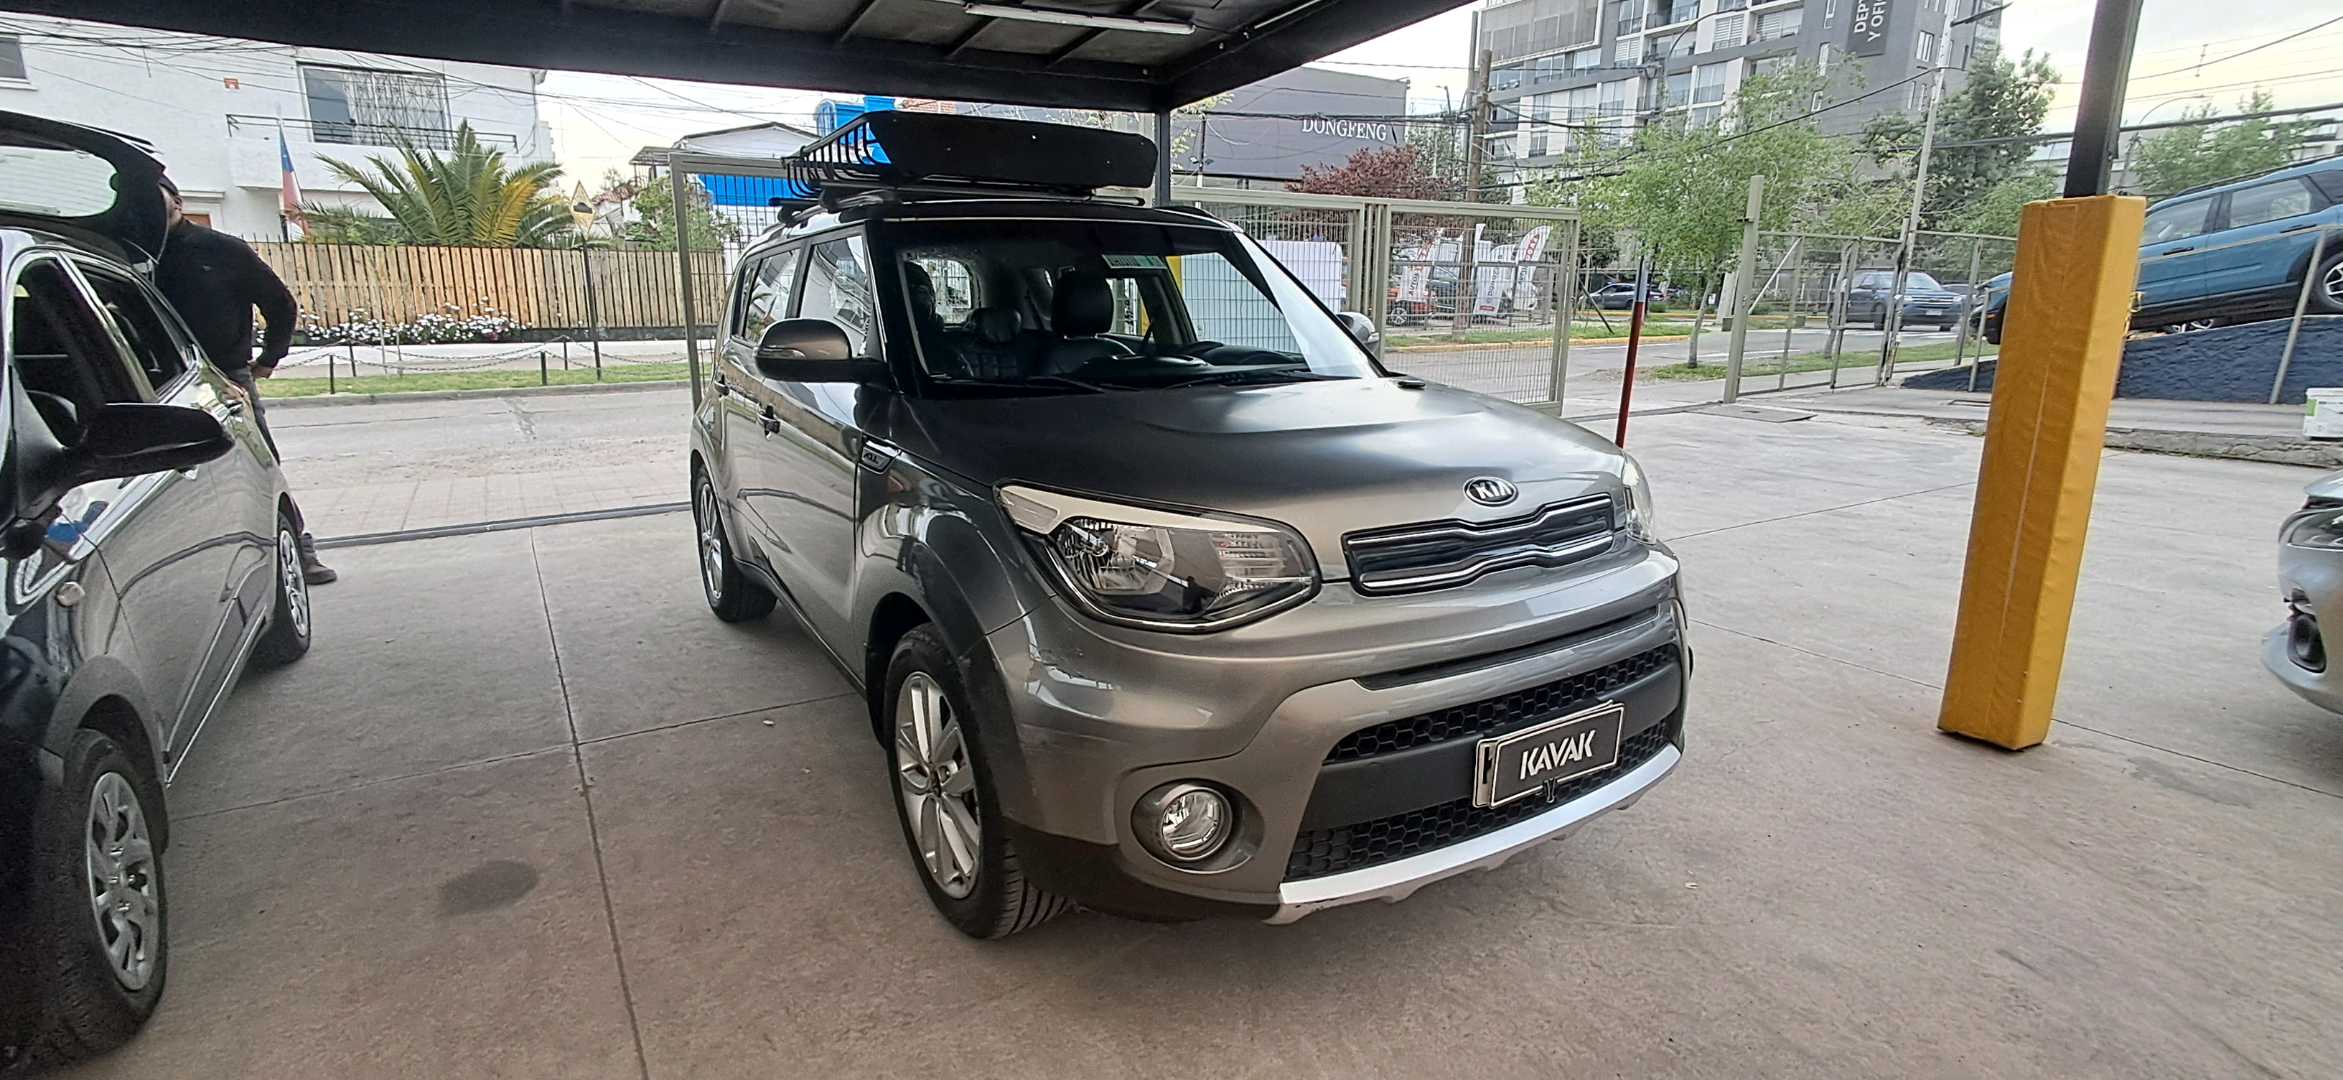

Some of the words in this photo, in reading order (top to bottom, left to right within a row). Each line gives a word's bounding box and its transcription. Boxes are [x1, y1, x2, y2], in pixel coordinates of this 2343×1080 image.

[1871, 0, 1887, 27] OFI
[1867, 31, 1881, 42] Y
[1302, 118, 1387, 141] DONGFENG
[1472, 480, 1513, 499] KIA
[1519, 729, 1596, 780] KAVAK
